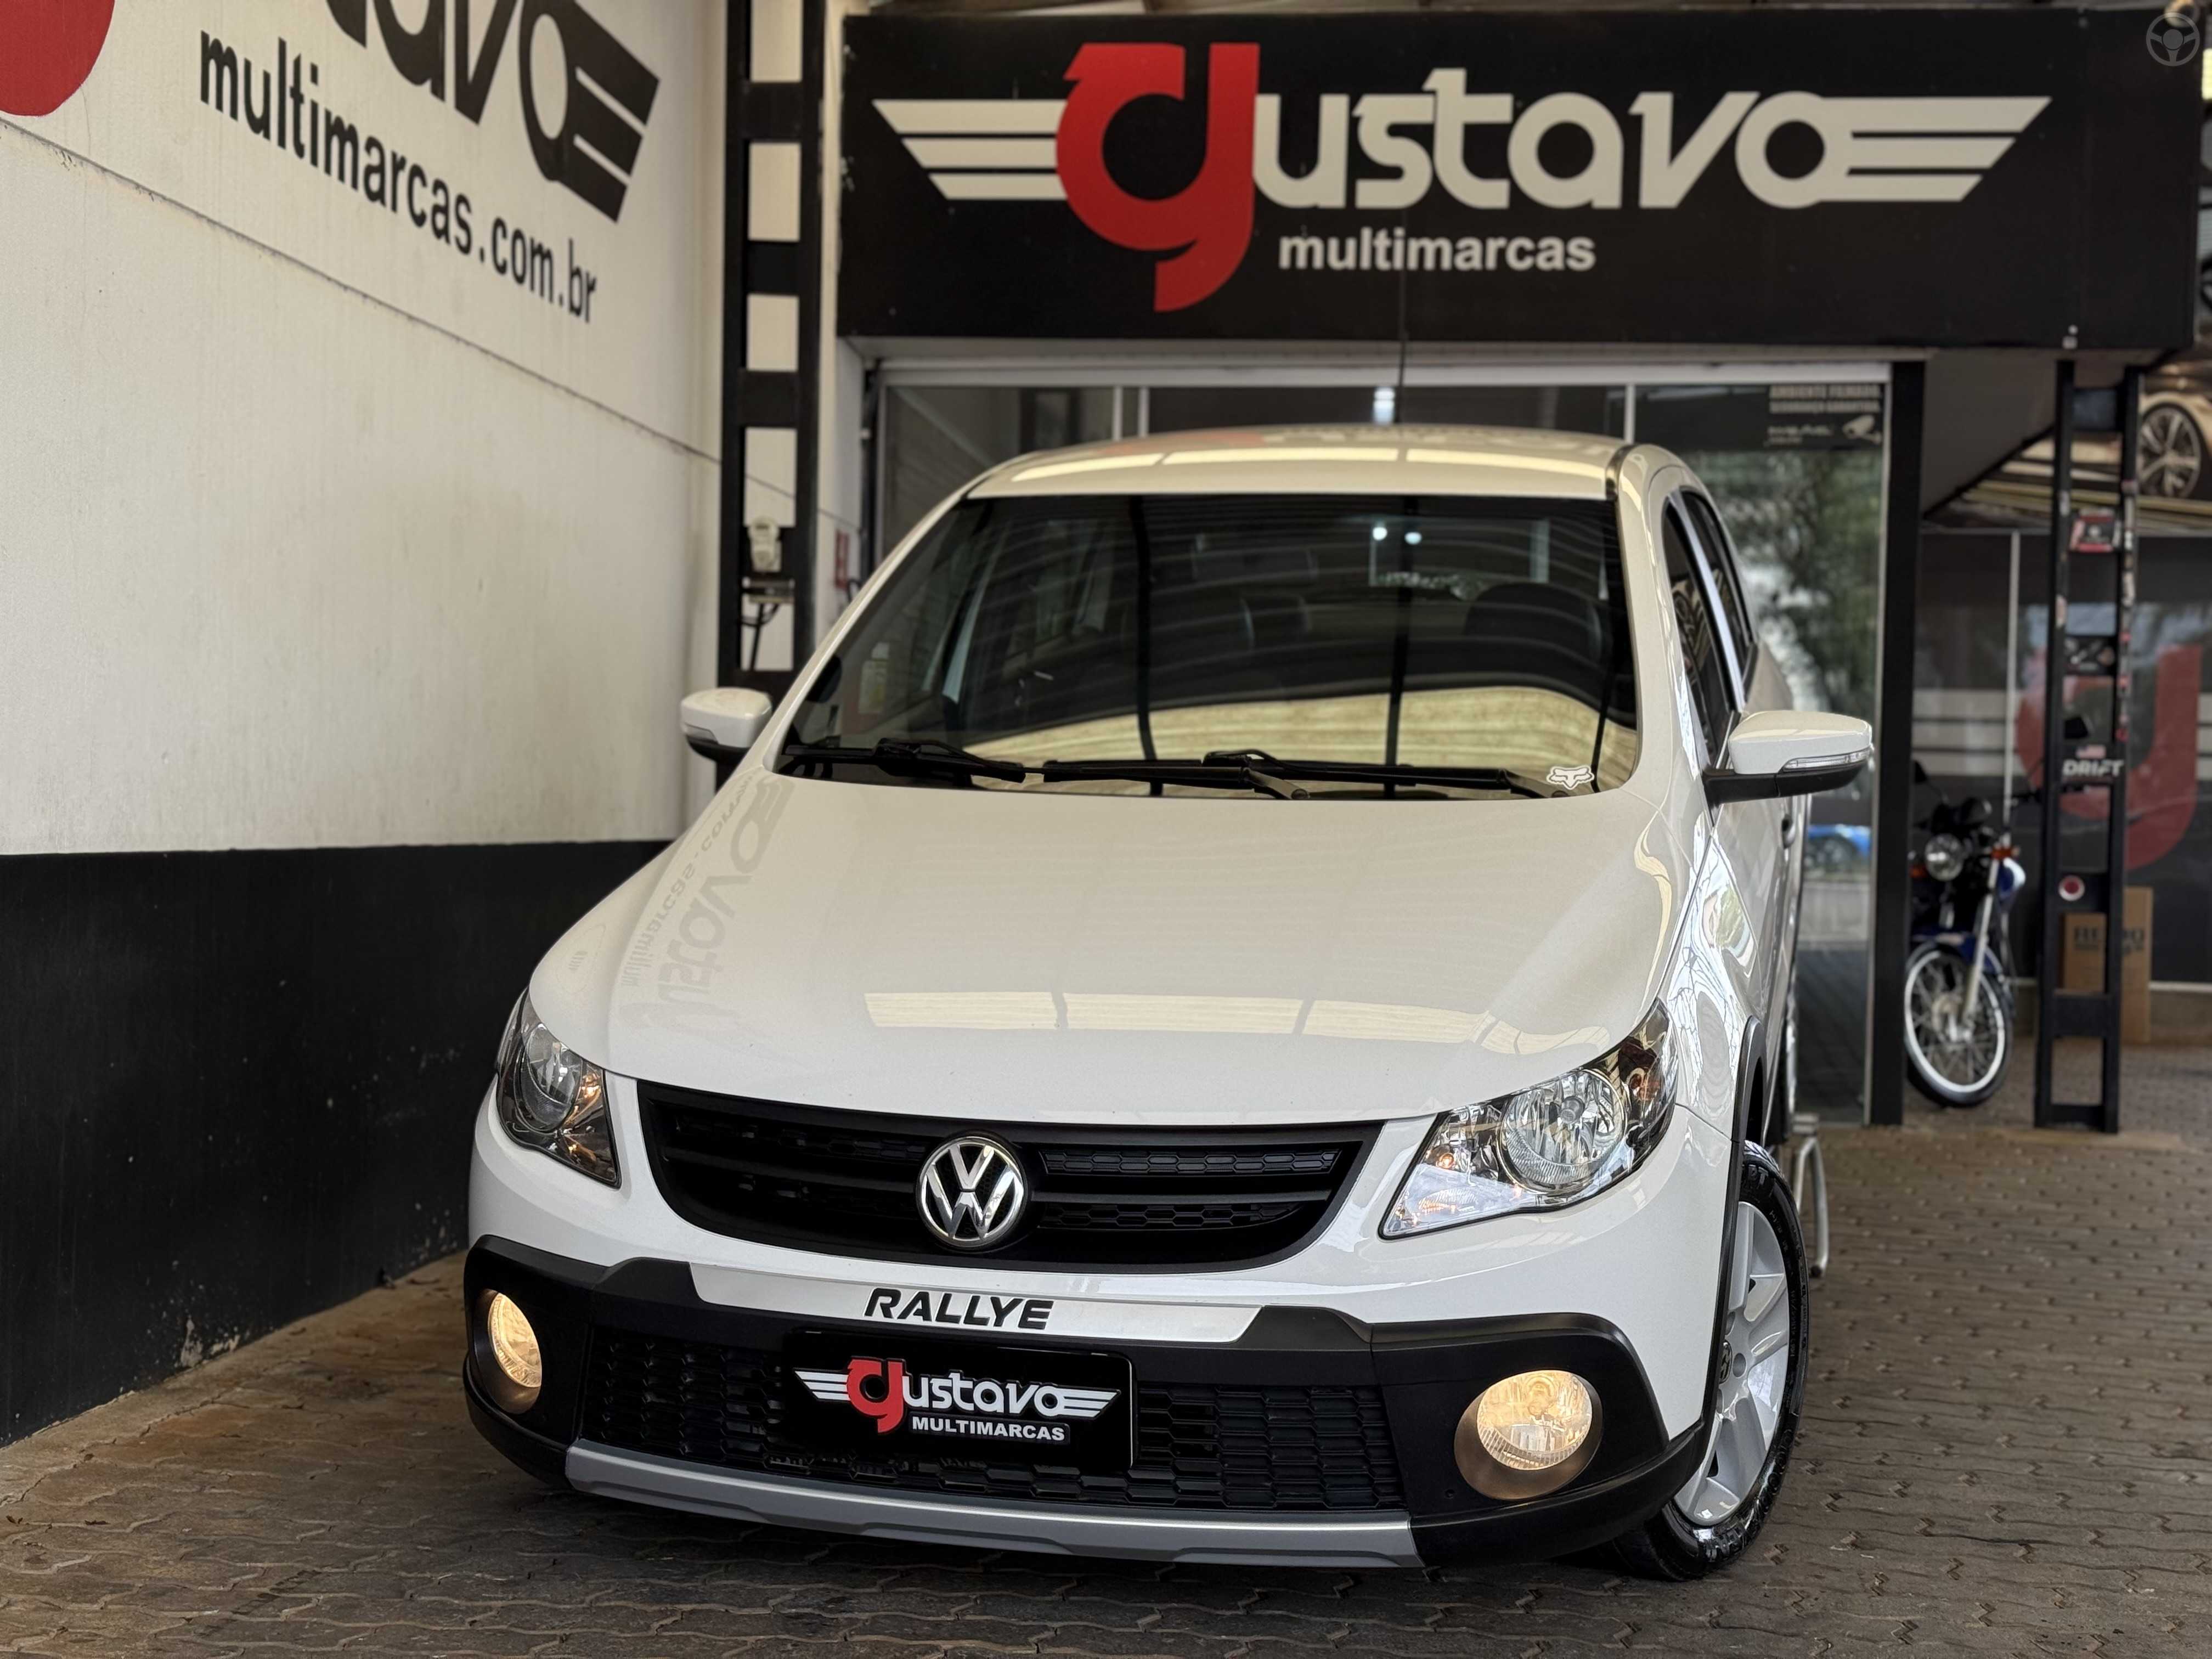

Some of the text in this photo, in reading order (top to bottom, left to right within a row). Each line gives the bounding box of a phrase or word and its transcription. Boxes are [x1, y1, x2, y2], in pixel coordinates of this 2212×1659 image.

[200, 30, 596, 323] multimarcas.com.br
[1056, 43, 1853, 311] gustavo
[1279, 227, 1596, 270] multimarcas
[2062, 759, 2125, 776] DRIFT
[863, 1288, 1054, 1330] RALLYE
[847, 1358, 1065, 1434] gustavo
[911, 1415, 1065, 1442] MULTIMARCAS
